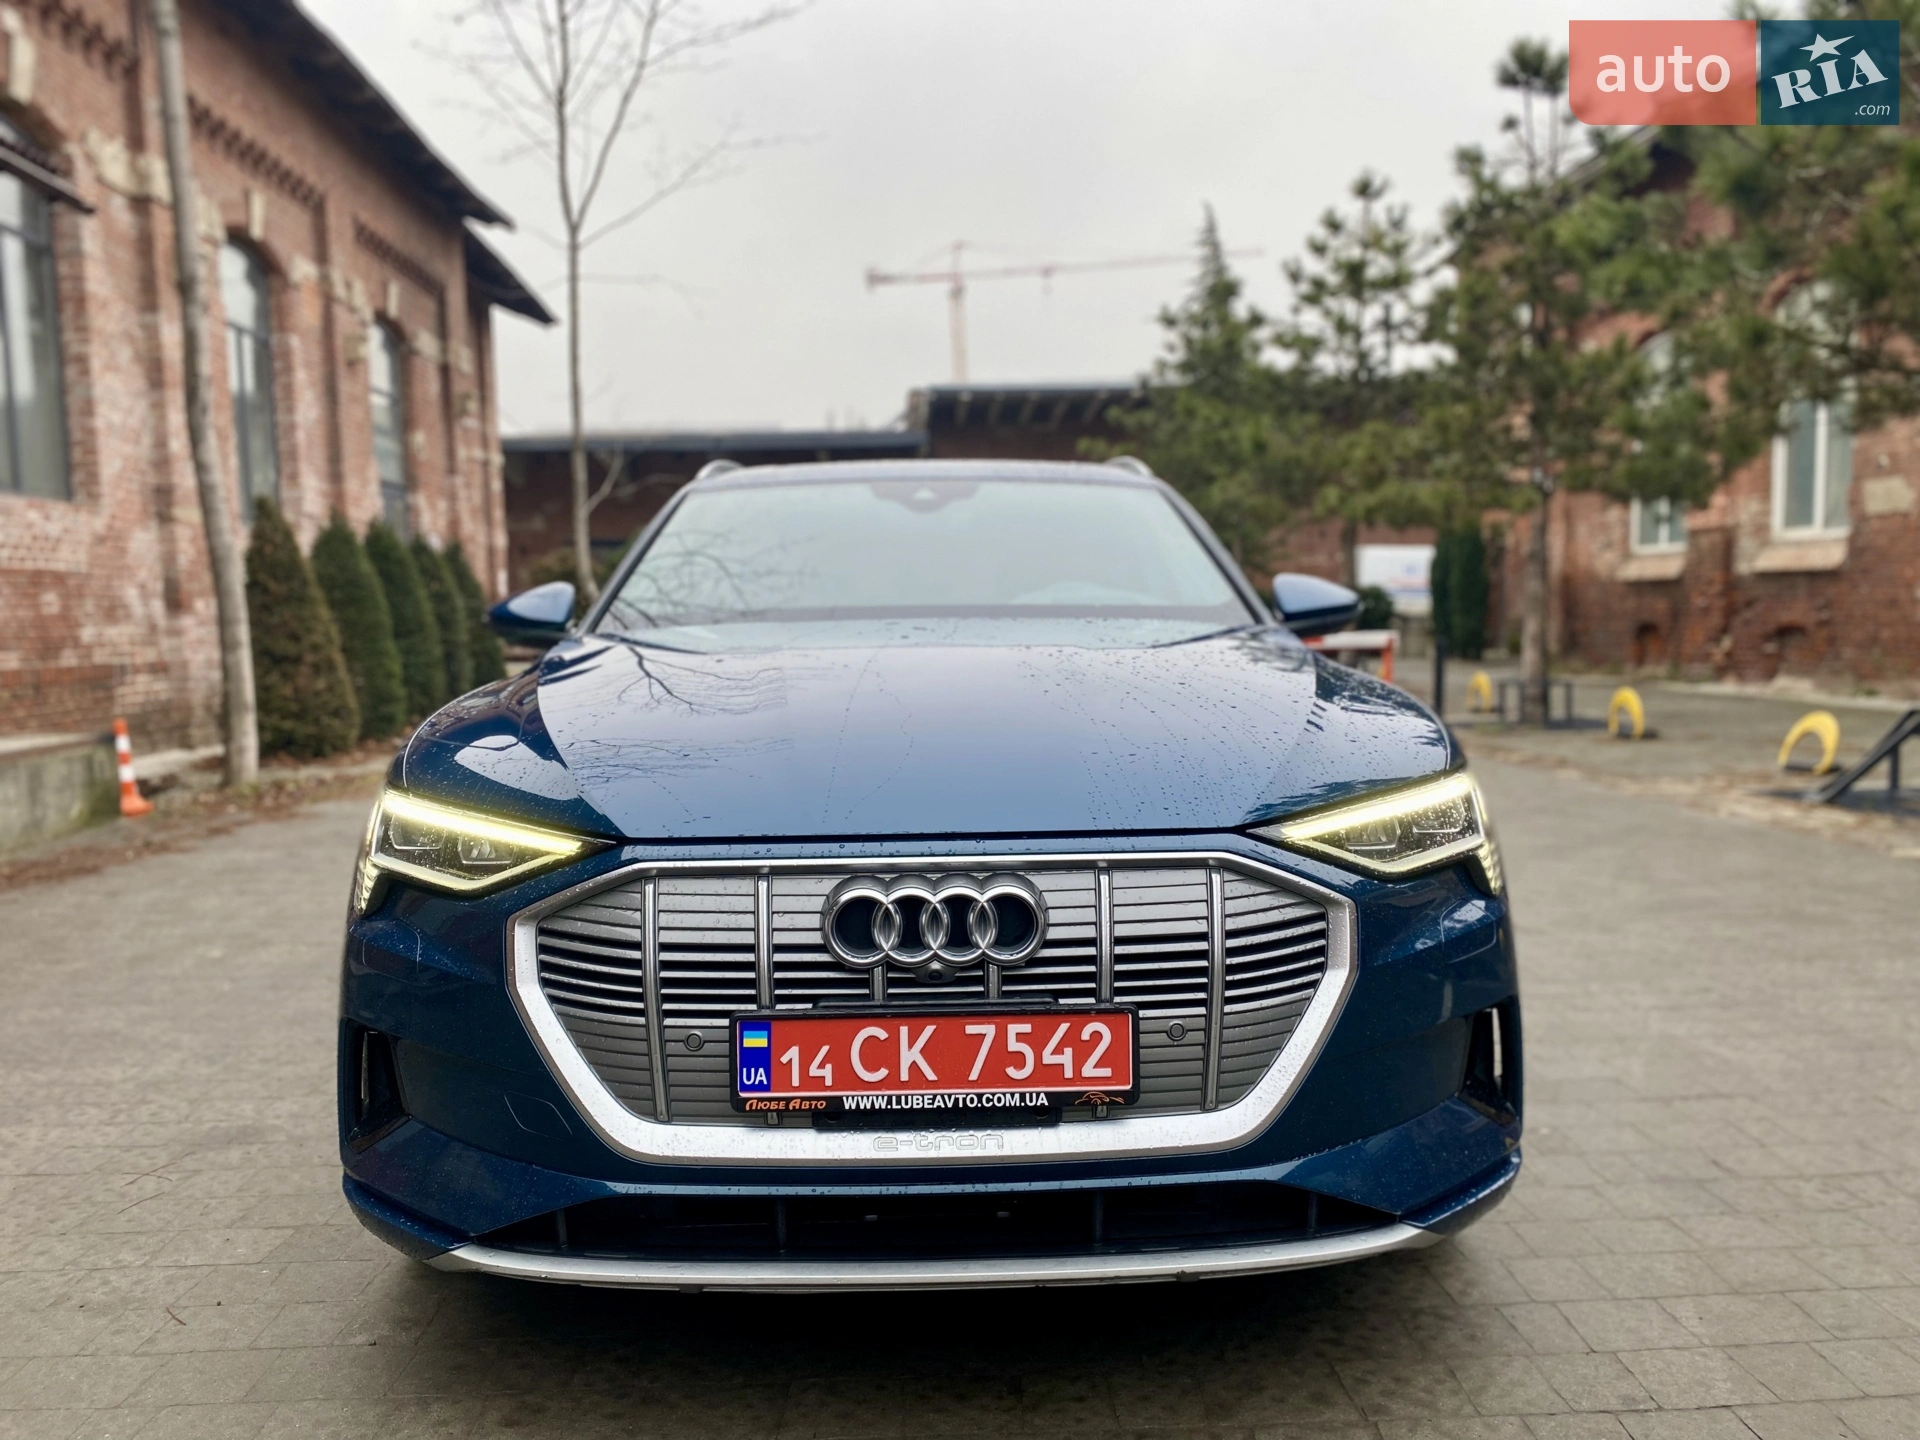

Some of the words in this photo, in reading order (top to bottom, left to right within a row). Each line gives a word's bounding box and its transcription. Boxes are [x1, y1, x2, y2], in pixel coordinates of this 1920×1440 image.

[779, 1045, 833, 1088] 14
[850, 1025, 938, 1082] CK
[964, 1022, 1113, 1081] 7542
[742, 1067, 768, 1086] UA
[842, 1093, 1049, 1110] WWW.LUBEAVTO.COM.UA
[872, 1133, 1005, 1152] e-tron
